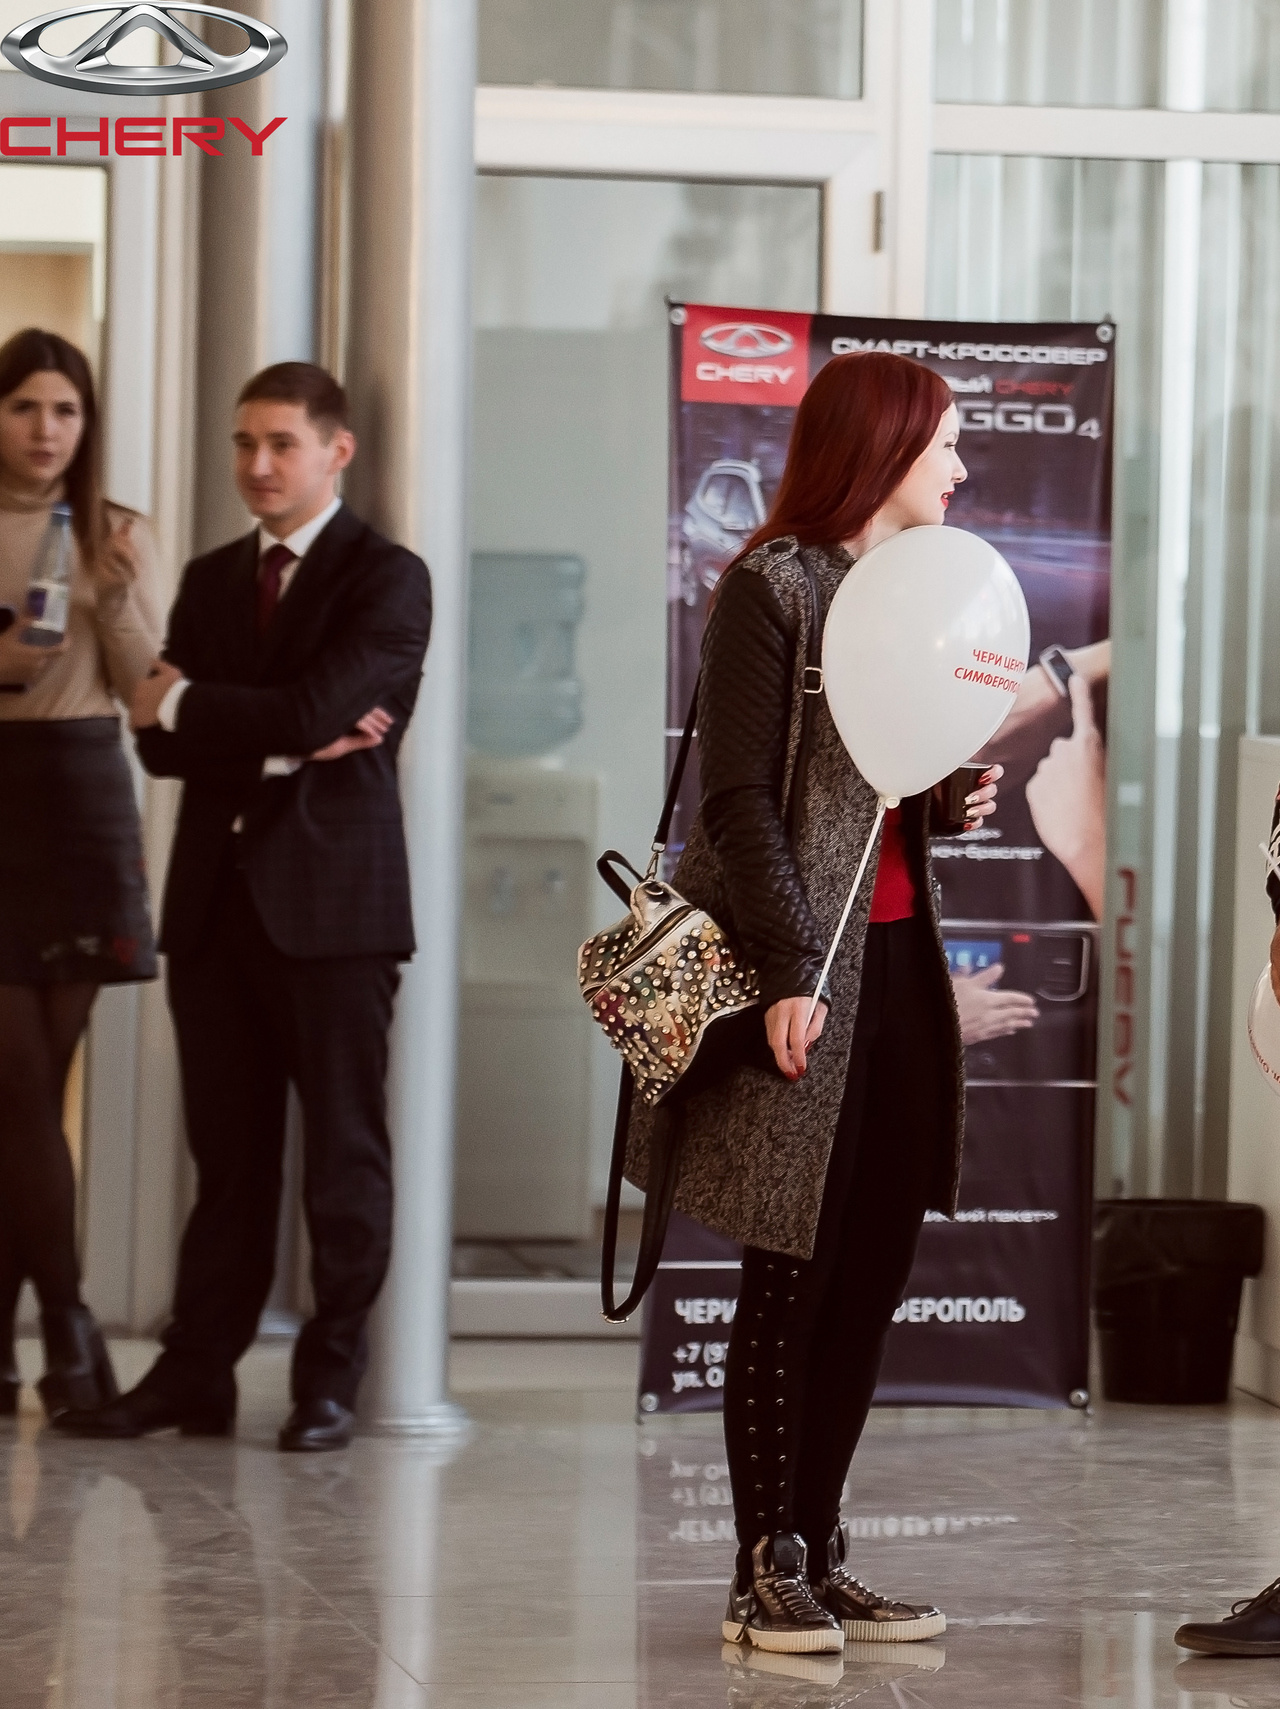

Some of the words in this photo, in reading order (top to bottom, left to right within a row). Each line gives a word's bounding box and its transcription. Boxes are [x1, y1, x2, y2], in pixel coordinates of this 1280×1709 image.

[831, 337, 1109, 366] СМАРТ-КРОССОВЕР
[696, 362, 796, 385] CHERY
[957, 401, 1077, 435] GGO
[1076, 417, 1102, 440] 4
[972, 649, 1003, 667] ЧЕРИ
[674, 1297, 738, 1324] ЧЕРИ
[891, 1297, 1027, 1323] ЕРОПОЛЬ
